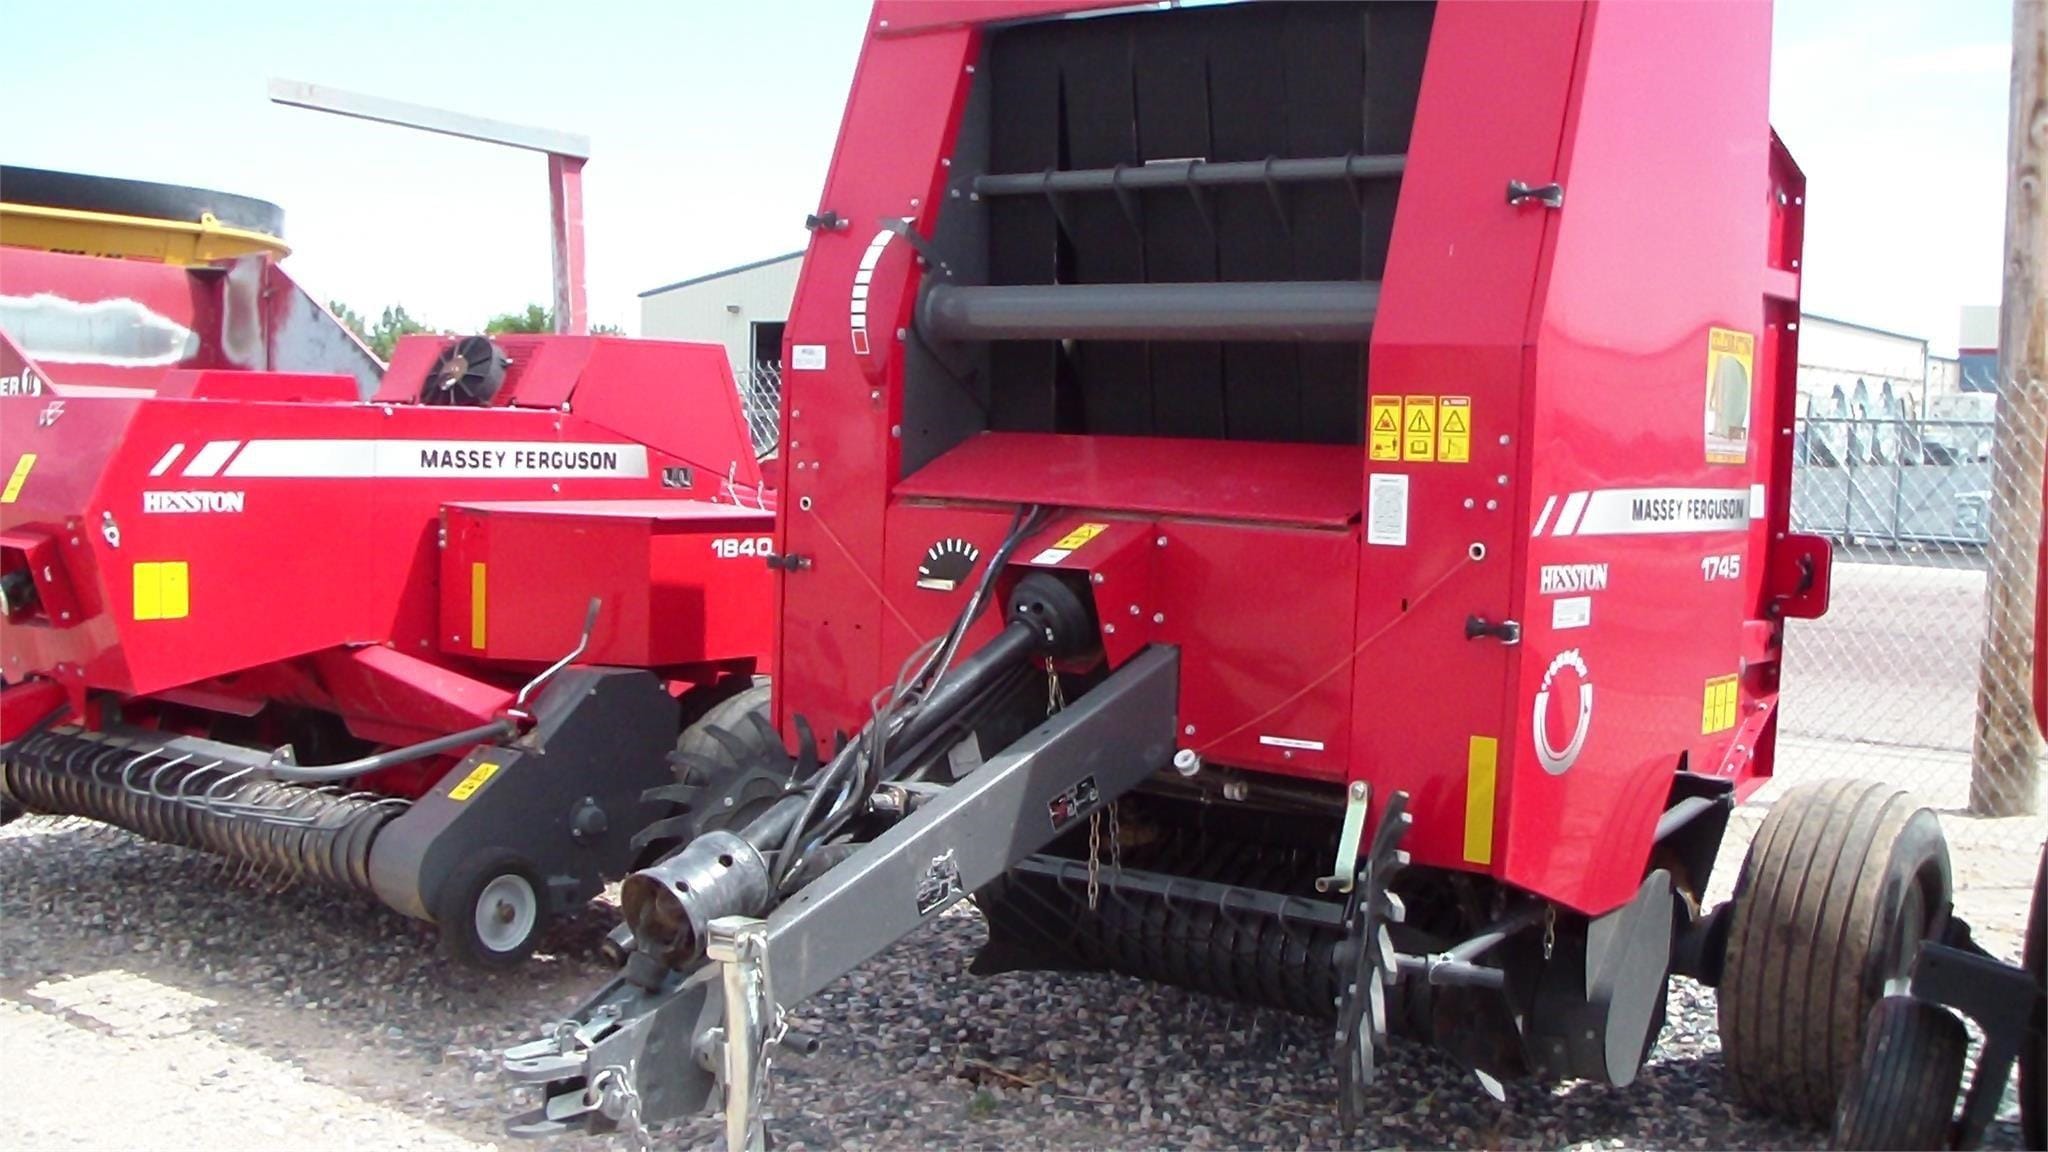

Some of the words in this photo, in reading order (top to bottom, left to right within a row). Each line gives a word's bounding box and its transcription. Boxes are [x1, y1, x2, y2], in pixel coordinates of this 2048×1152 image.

[420, 449, 506, 469] MASSEY
[514, 450, 617, 470] FERGUSON
[143, 490, 246, 514] HESSTON
[1631, 499, 1682, 521] MASSEY
[1686, 499, 1745, 520] FERGUSON
[711, 537, 774, 558] 1840
[1540, 562, 1609, 594] HESSTON
[1701, 554, 1741, 581] 1745
